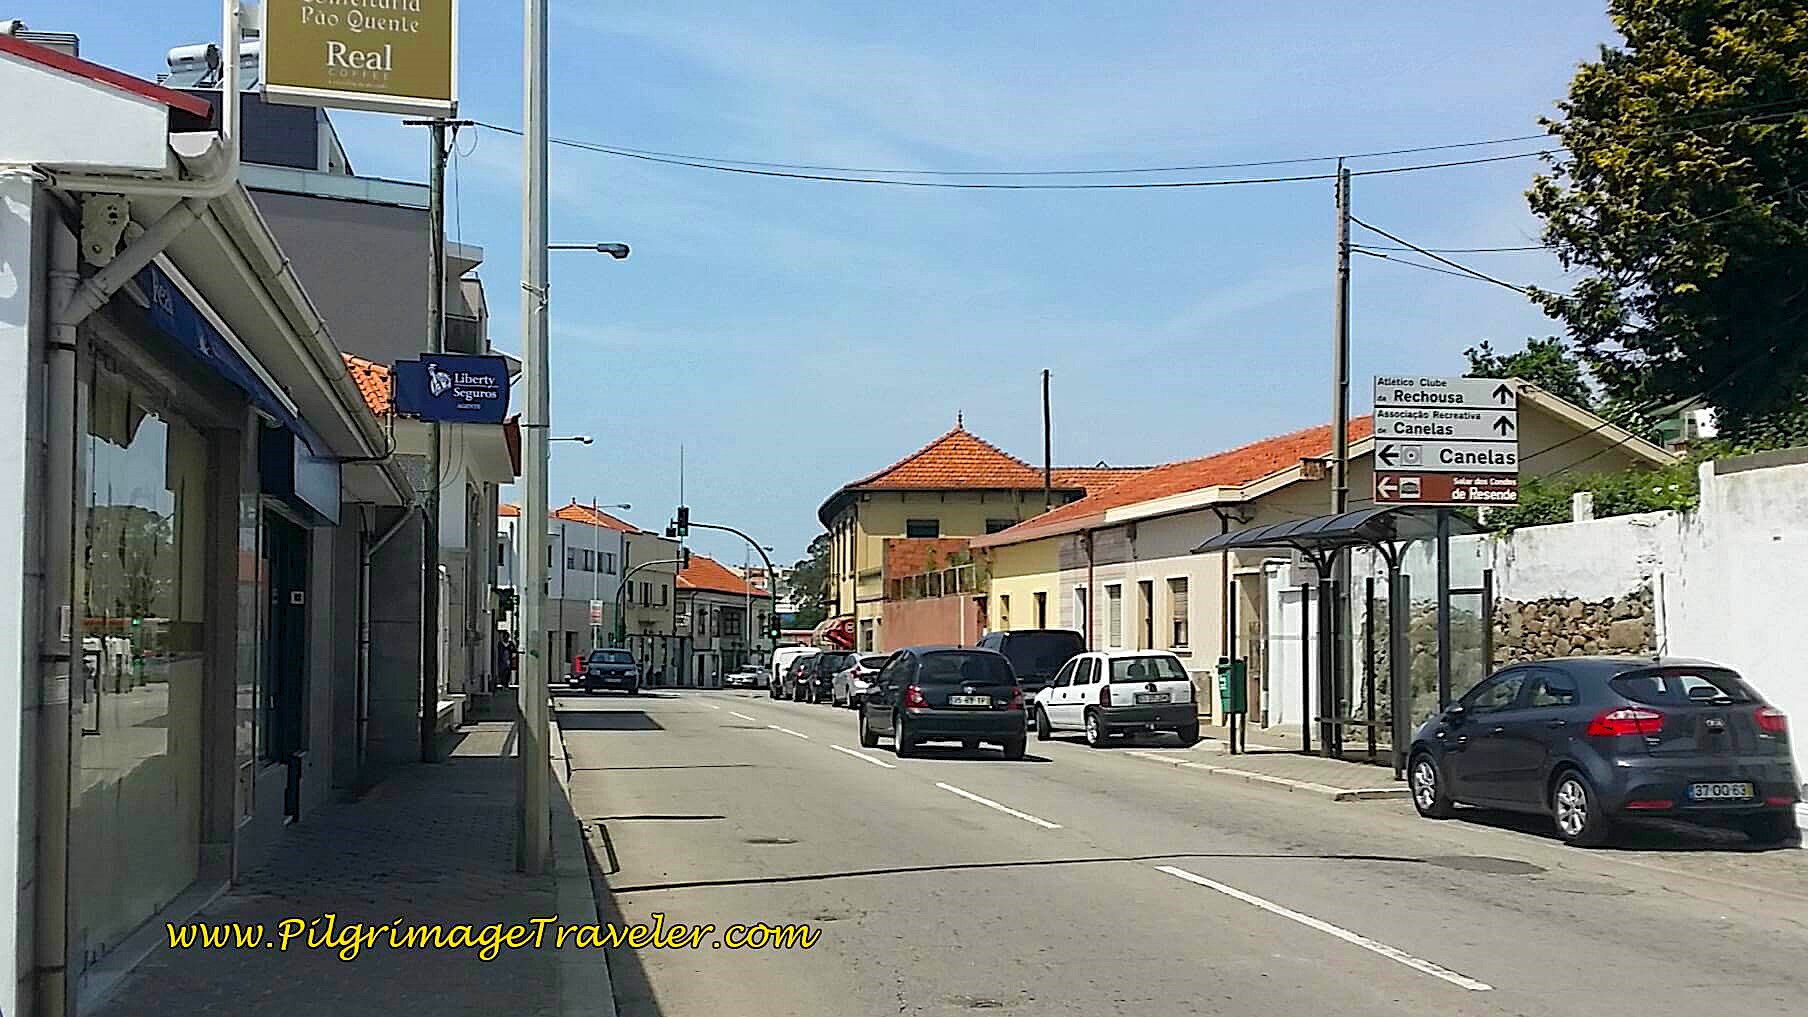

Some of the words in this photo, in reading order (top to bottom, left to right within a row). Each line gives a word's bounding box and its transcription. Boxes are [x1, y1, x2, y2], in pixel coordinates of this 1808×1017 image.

[347, 9, 419, 33] Quente
[326, 40, 392, 71] Real
[454, 372, 496, 389] Liberty
[1419, 378, 1448, 388] Clube
[453, 386, 497, 401] Seguros
[1393, 389, 1464, 404] Rechousa
[1432, 410, 1481, 421] Recreativa
[1394, 421, 1454, 435] Canelas
[1439, 448, 1516, 465] Canelas
[1452, 487, 1467, 500] de
[1469, 486, 1518, 501] Resende
